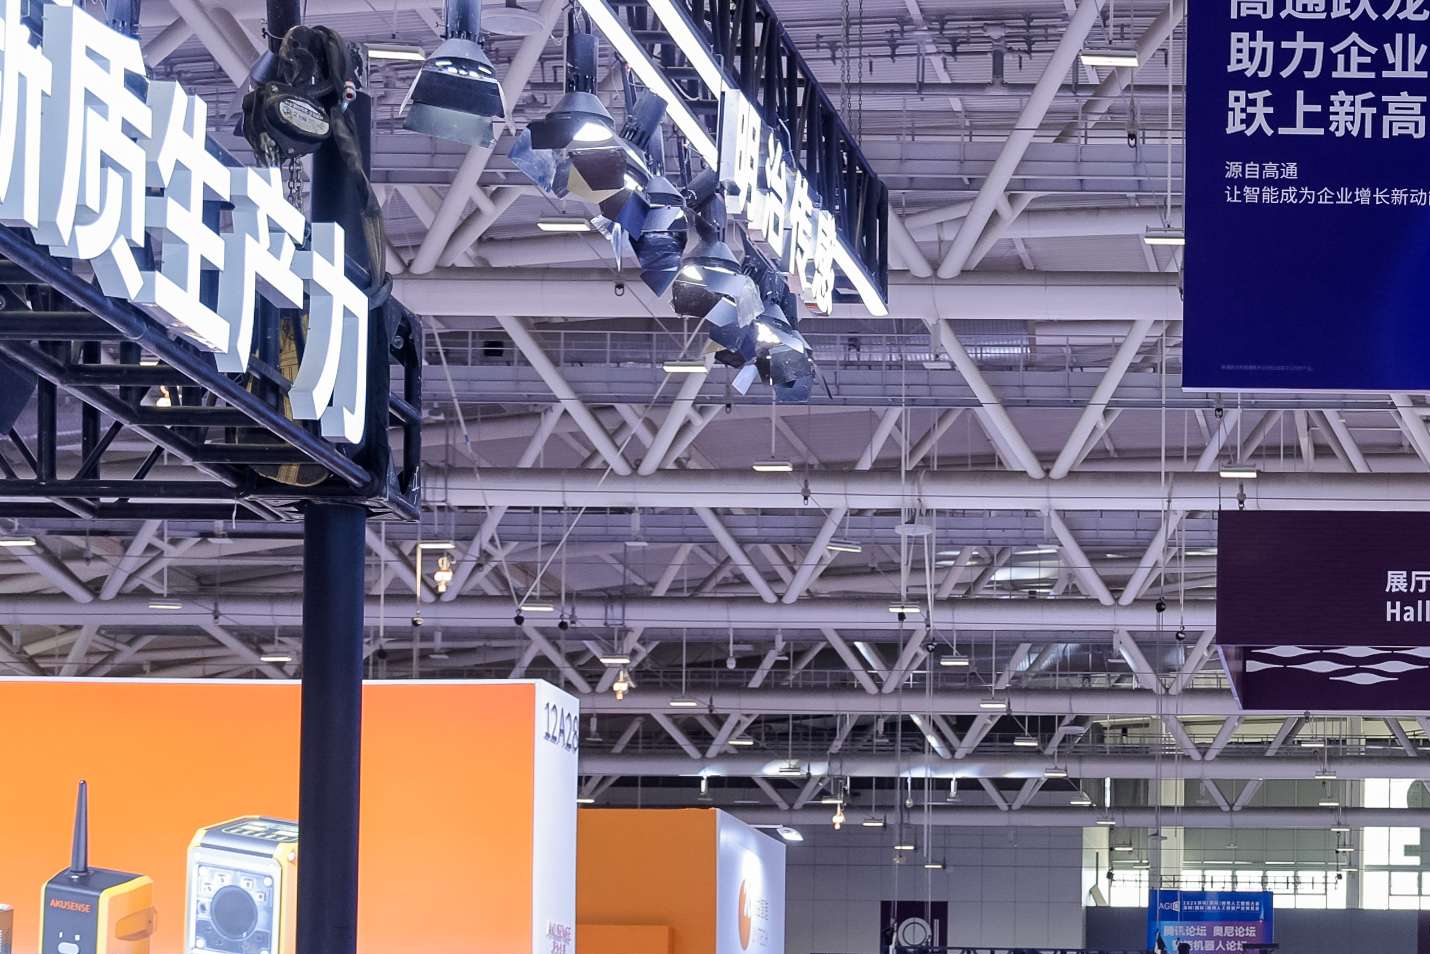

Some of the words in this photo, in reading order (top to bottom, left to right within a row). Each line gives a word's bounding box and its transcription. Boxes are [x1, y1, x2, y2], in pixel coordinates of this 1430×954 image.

[1226, 30, 1429, 79] 助力企业
[1224, 161, 1299, 181] 源自高通
[1386, 600, 1430, 623] Hall
